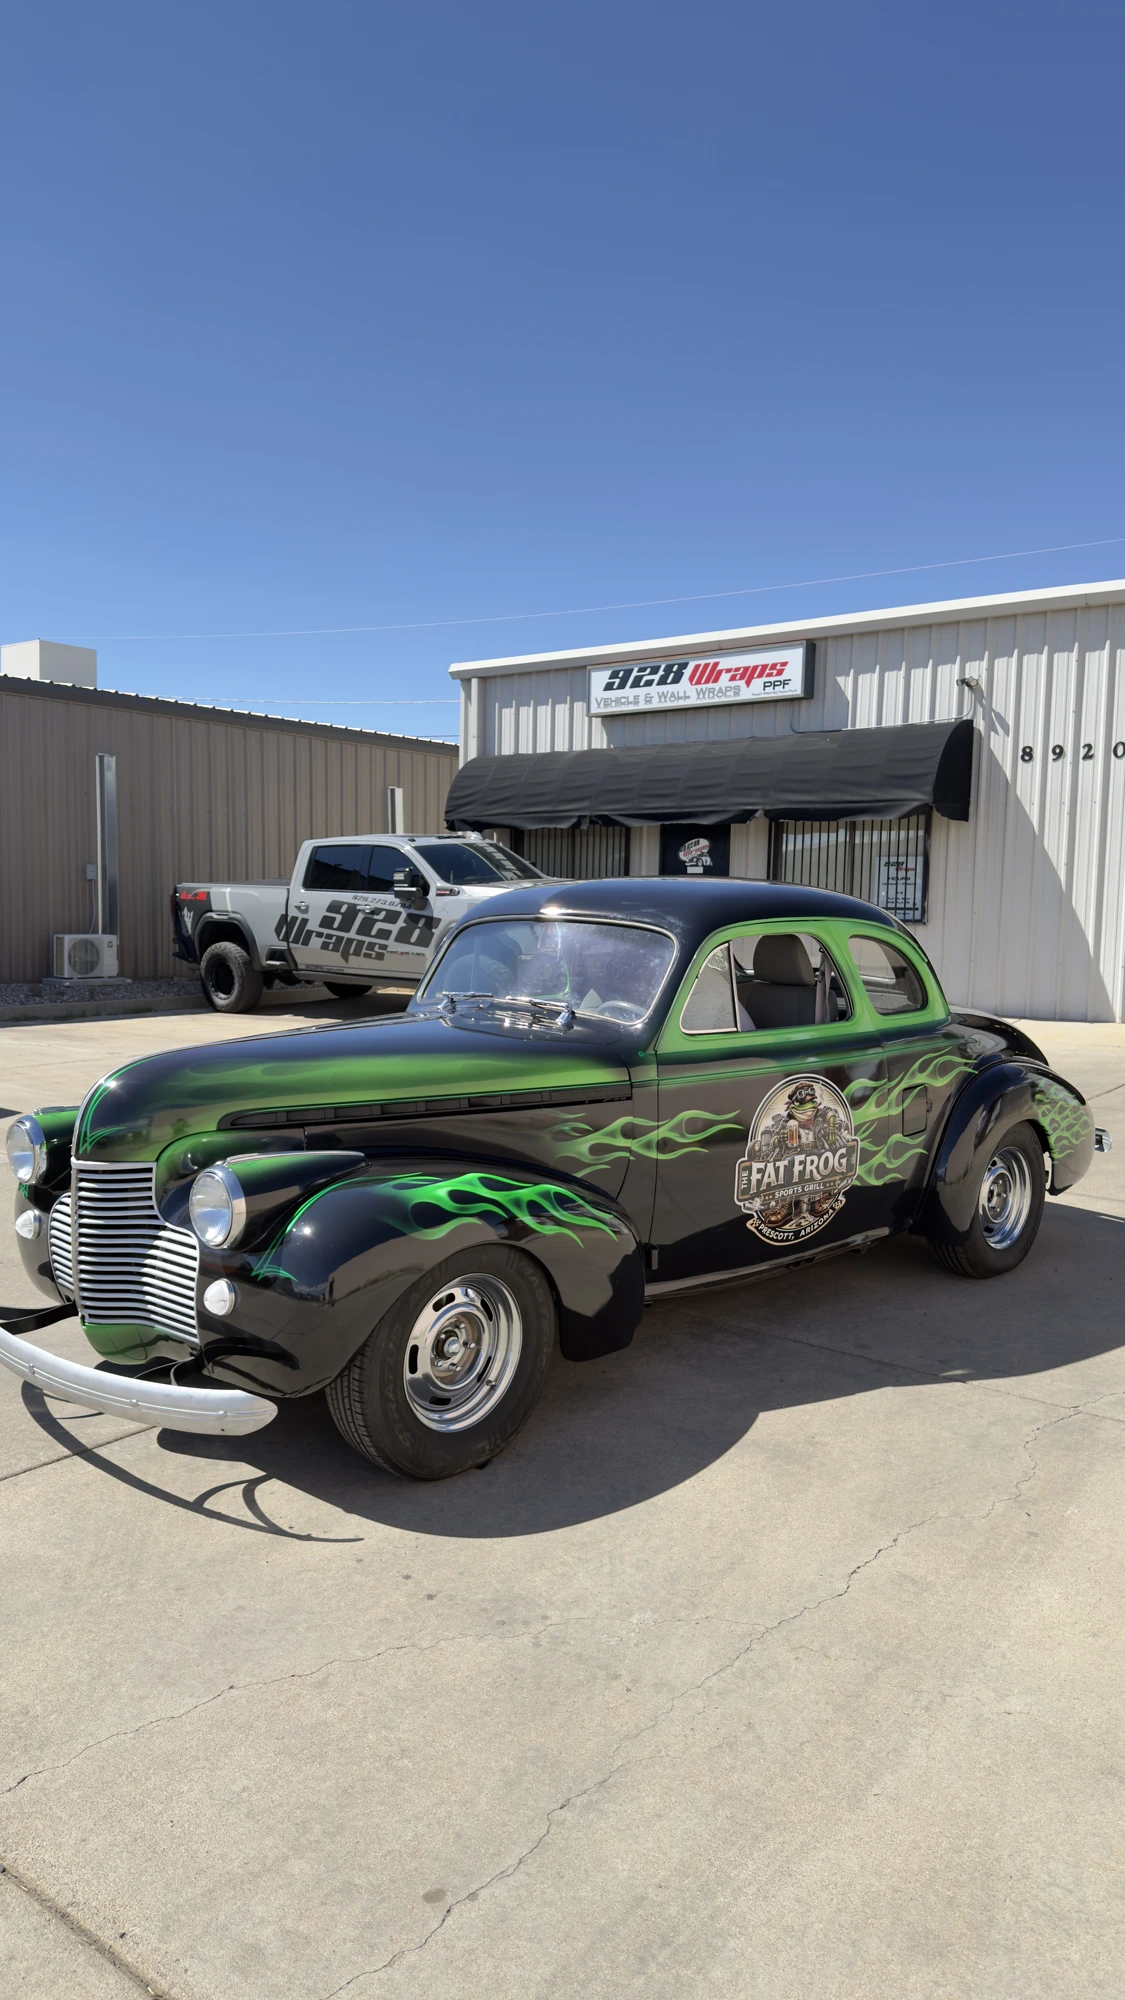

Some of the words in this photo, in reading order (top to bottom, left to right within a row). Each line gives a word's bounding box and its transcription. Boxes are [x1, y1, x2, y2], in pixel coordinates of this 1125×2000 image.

[602, 662, 689, 691] 928
[688, 661, 788, 688] Wraps
[763, 679, 791, 691] PPF
[595, 695, 640, 706] VEHICLE
[644, 693, 654, 702] &
[657, 690, 691, 701] WALL
[695, 685, 741, 697] WRAPS
[195, 891, 207, 900] 3M
[318, 899, 442, 948] 928
[274, 914, 388, 965] Wraps
[741, 1170, 749, 1189] THE
[749, 1160, 788, 1194] FAT
[793, 1148, 847, 1182] FROG
[775, 1186, 802, 1199] SPORTS
[804, 1182, 824, 1191] GRILL
[758, 1223, 795, 1240] PRESCOTT,
[800, 1209, 834, 1236] ARIZONA
